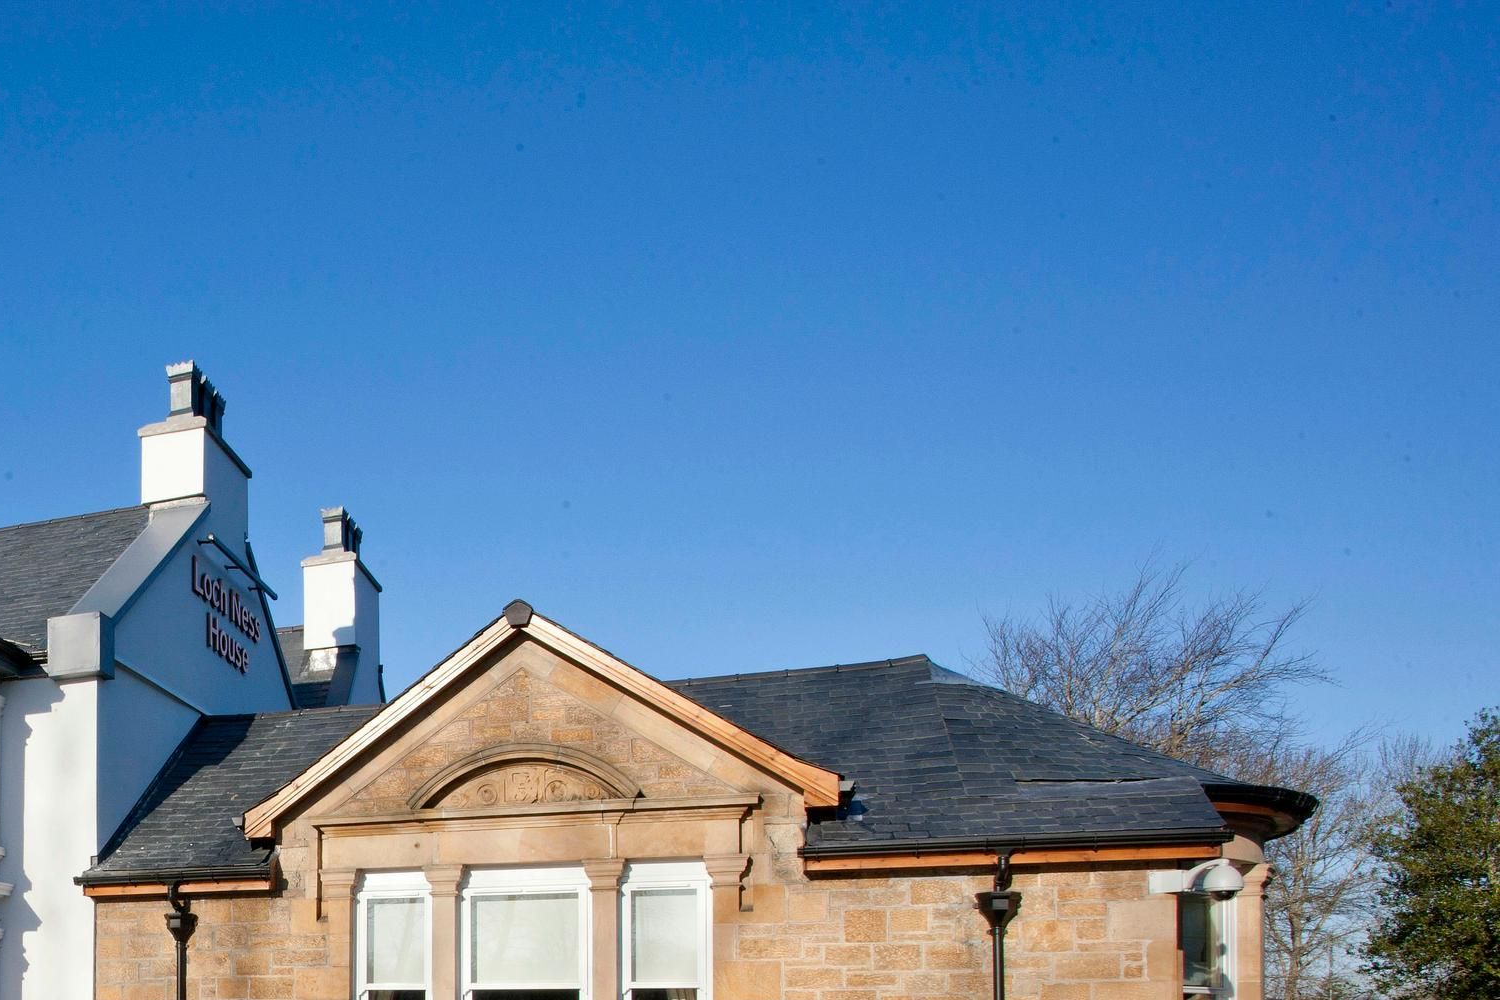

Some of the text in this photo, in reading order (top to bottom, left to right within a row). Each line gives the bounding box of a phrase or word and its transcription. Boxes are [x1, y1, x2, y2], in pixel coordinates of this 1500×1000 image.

[192, 555, 261, 643] Loch Ness
[207, 612, 250, 674] House
